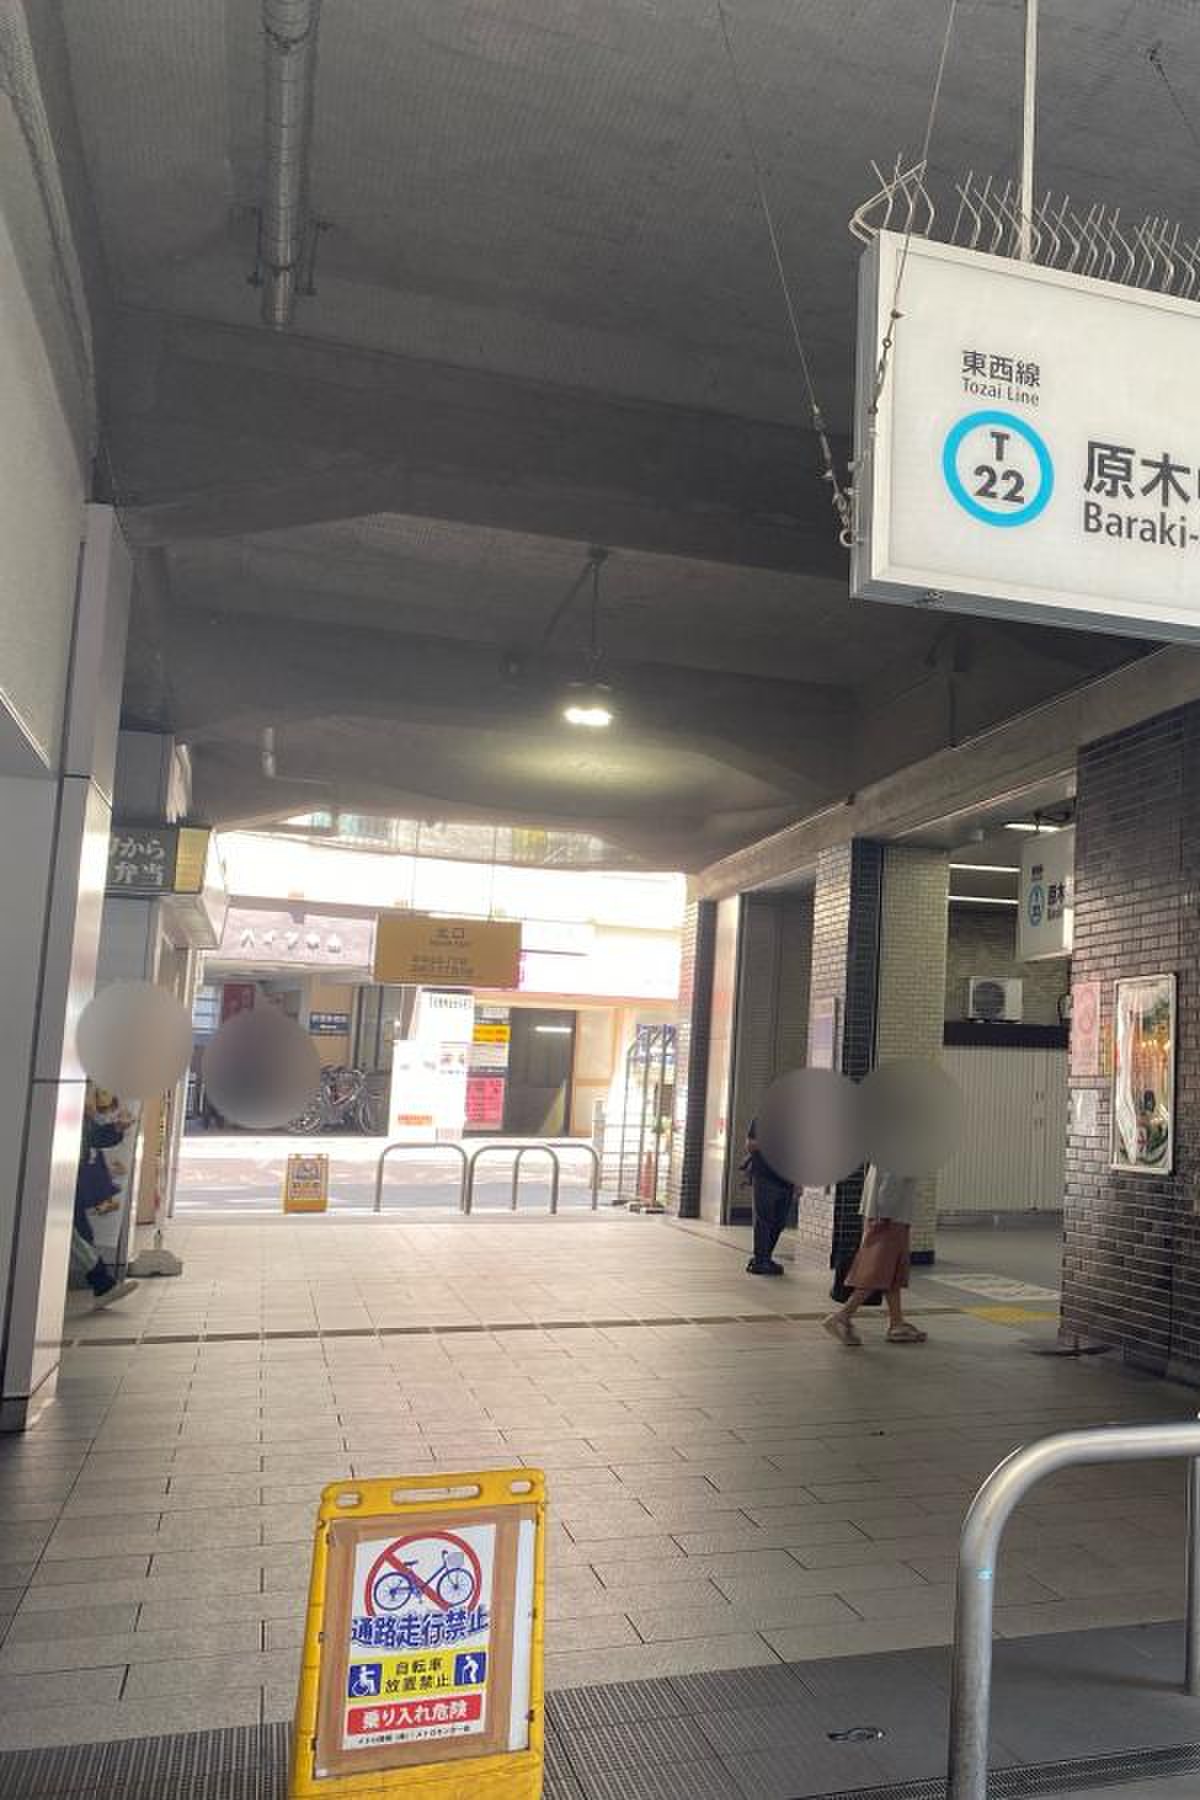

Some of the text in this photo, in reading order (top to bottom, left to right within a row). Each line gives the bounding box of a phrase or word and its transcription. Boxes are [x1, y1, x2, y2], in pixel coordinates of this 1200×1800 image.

[962, 350, 1040, 387] 東西線
[962, 377, 1040, 407] Tozai Line
[990, 431, 1010, 462] T
[973, 464, 1025, 504] 22
[114, 861, 164, 884] 弁当
[351, 1606, 489, 1648] 通路走行禁止
[395, 1658, 443, 1674] 自転車
[384, 1674, 449, 1693] 放置禁止
[363, 1699, 467, 1729] 乗り入れ危険
